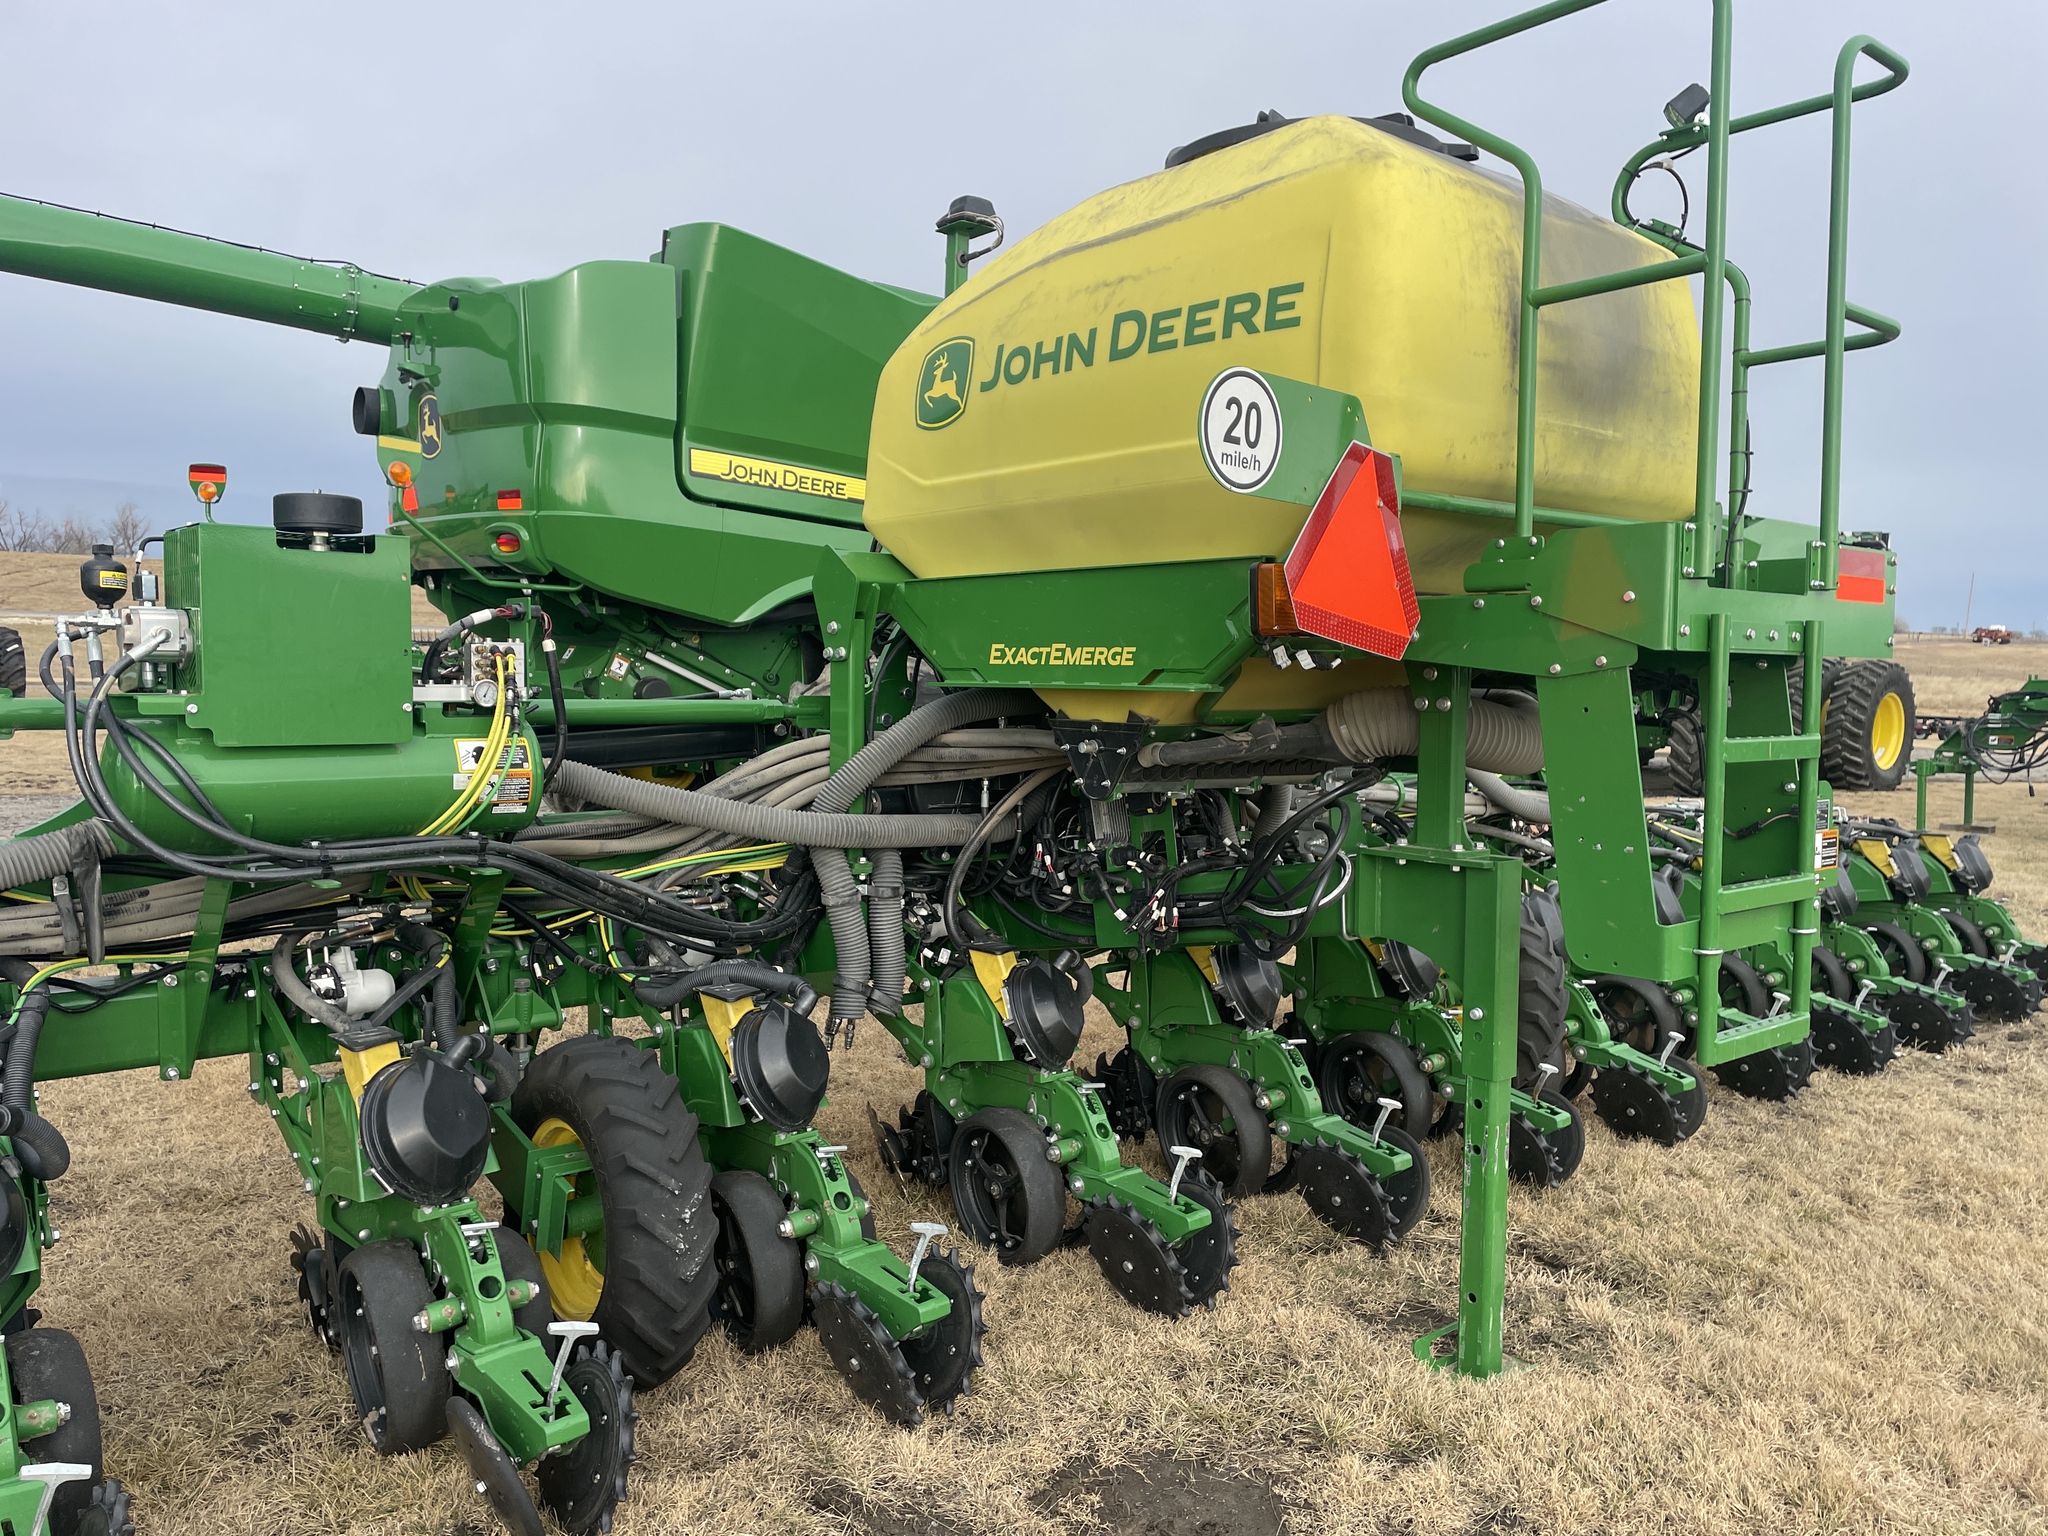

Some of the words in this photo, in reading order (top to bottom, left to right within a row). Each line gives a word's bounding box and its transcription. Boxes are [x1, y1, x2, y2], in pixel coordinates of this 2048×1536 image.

[980, 327, 1098, 393] JOHN
[1108, 281, 1305, 363] DEERE
[1222, 396, 1262, 450] 20
[720, 459, 777, 485] JOHN
[783, 469, 847, 497] DEERE
[1221, 450, 1261, 472] mile/h
[989, 643, 1137, 666] EXACTEMERGE
